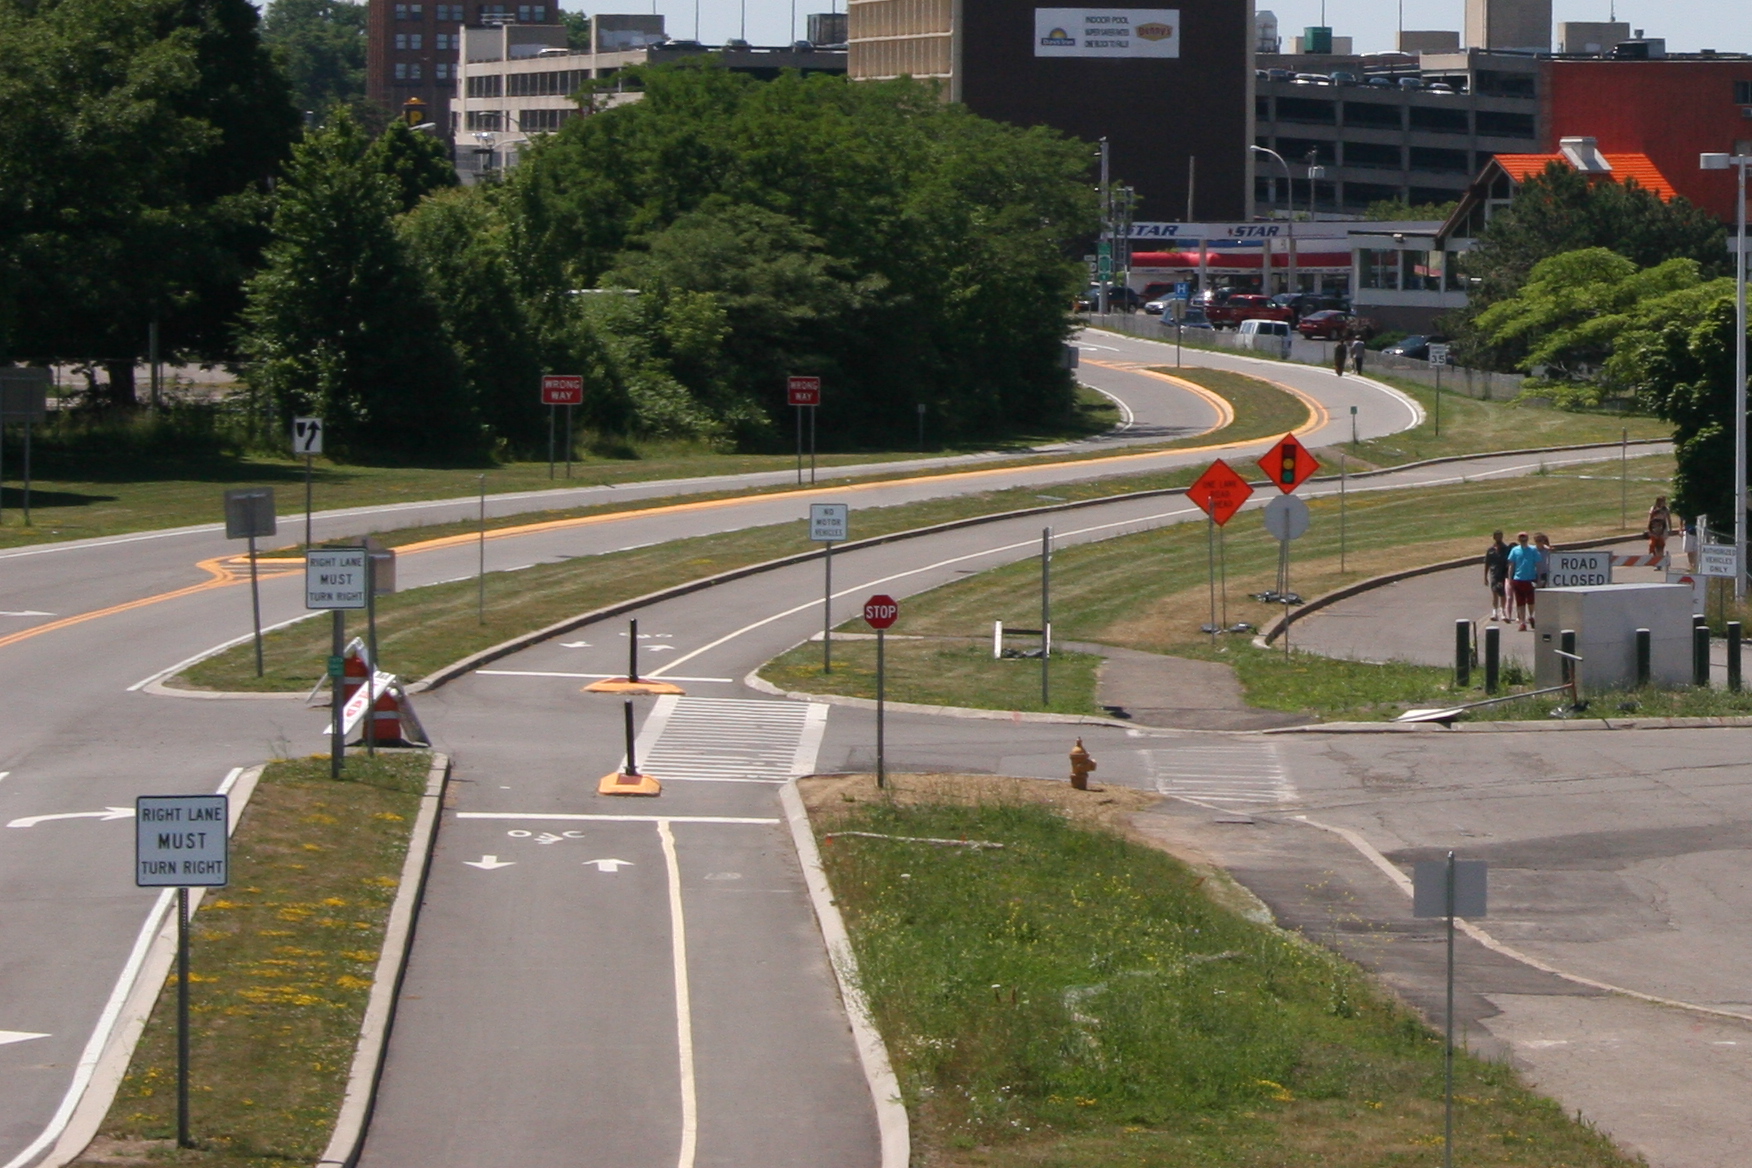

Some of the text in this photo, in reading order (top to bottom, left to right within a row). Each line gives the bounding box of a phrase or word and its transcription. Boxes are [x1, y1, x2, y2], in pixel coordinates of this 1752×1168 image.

[1112, 16, 1129, 24] POOL
[1234, 226, 1279, 237] STAR
[1431, 354, 1445, 363] 35
[545, 380, 580, 389] WRONG
[790, 381, 818, 390] WRONG
[552, 392, 573, 400] WAY
[824, 508, 834, 516] NO
[815, 529, 842, 537] VEHICLES
[310, 557, 362, 567] RIGHT LANE
[1561, 558, 1598, 570] ROAD
[1705, 556, 1732, 565] VEHICLES
[320, 574, 352, 585] MUST
[1553, 574, 1605, 586] CLOSED
[310, 592, 362, 601] TURN RIGHT
[866, 605, 897, 619] STOP
[142, 807, 222, 821] RIGHT LANE
[158, 833, 206, 849] MUST
[141, 860, 222, 874] TURN RIGHT
